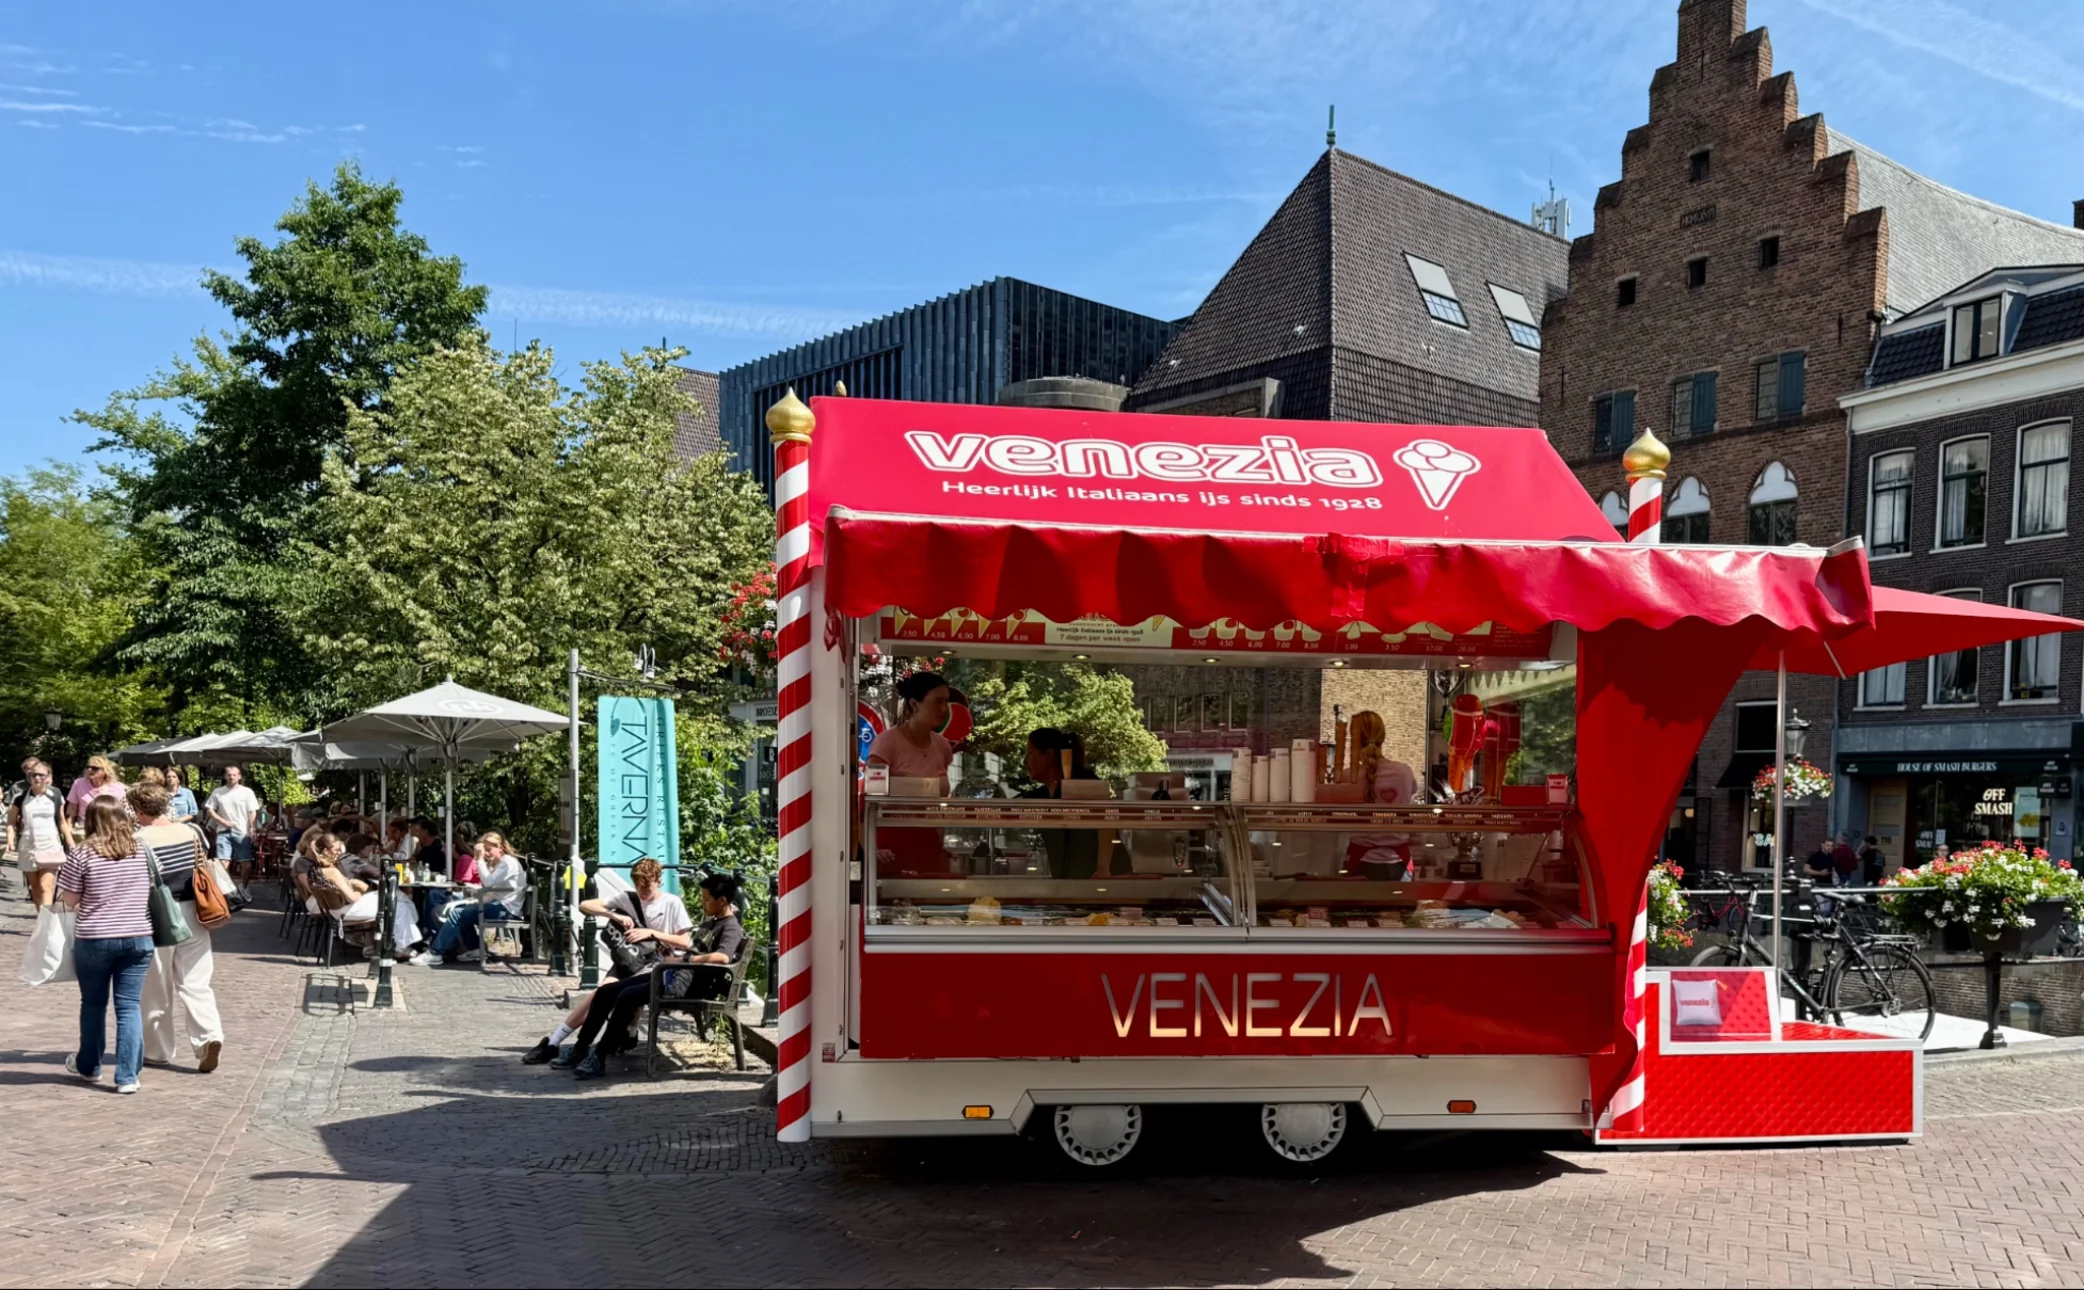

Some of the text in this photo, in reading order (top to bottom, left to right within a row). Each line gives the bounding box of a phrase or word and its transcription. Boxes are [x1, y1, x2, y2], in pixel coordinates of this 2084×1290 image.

[904, 430, 1384, 488] venezia
[942, 480, 1383, 510] Heerlijk Italiaans ijs sinds 1928
[656, 717, 665, 785] GRIEKS
[1897, 762, 1997, 772] HOUSE OF SMASH BURGERS
[621, 716, 649, 864] TAVERNA
[1974, 802, 2013, 815] SMASH
[1101, 973, 1392, 1037] VENEZIA
